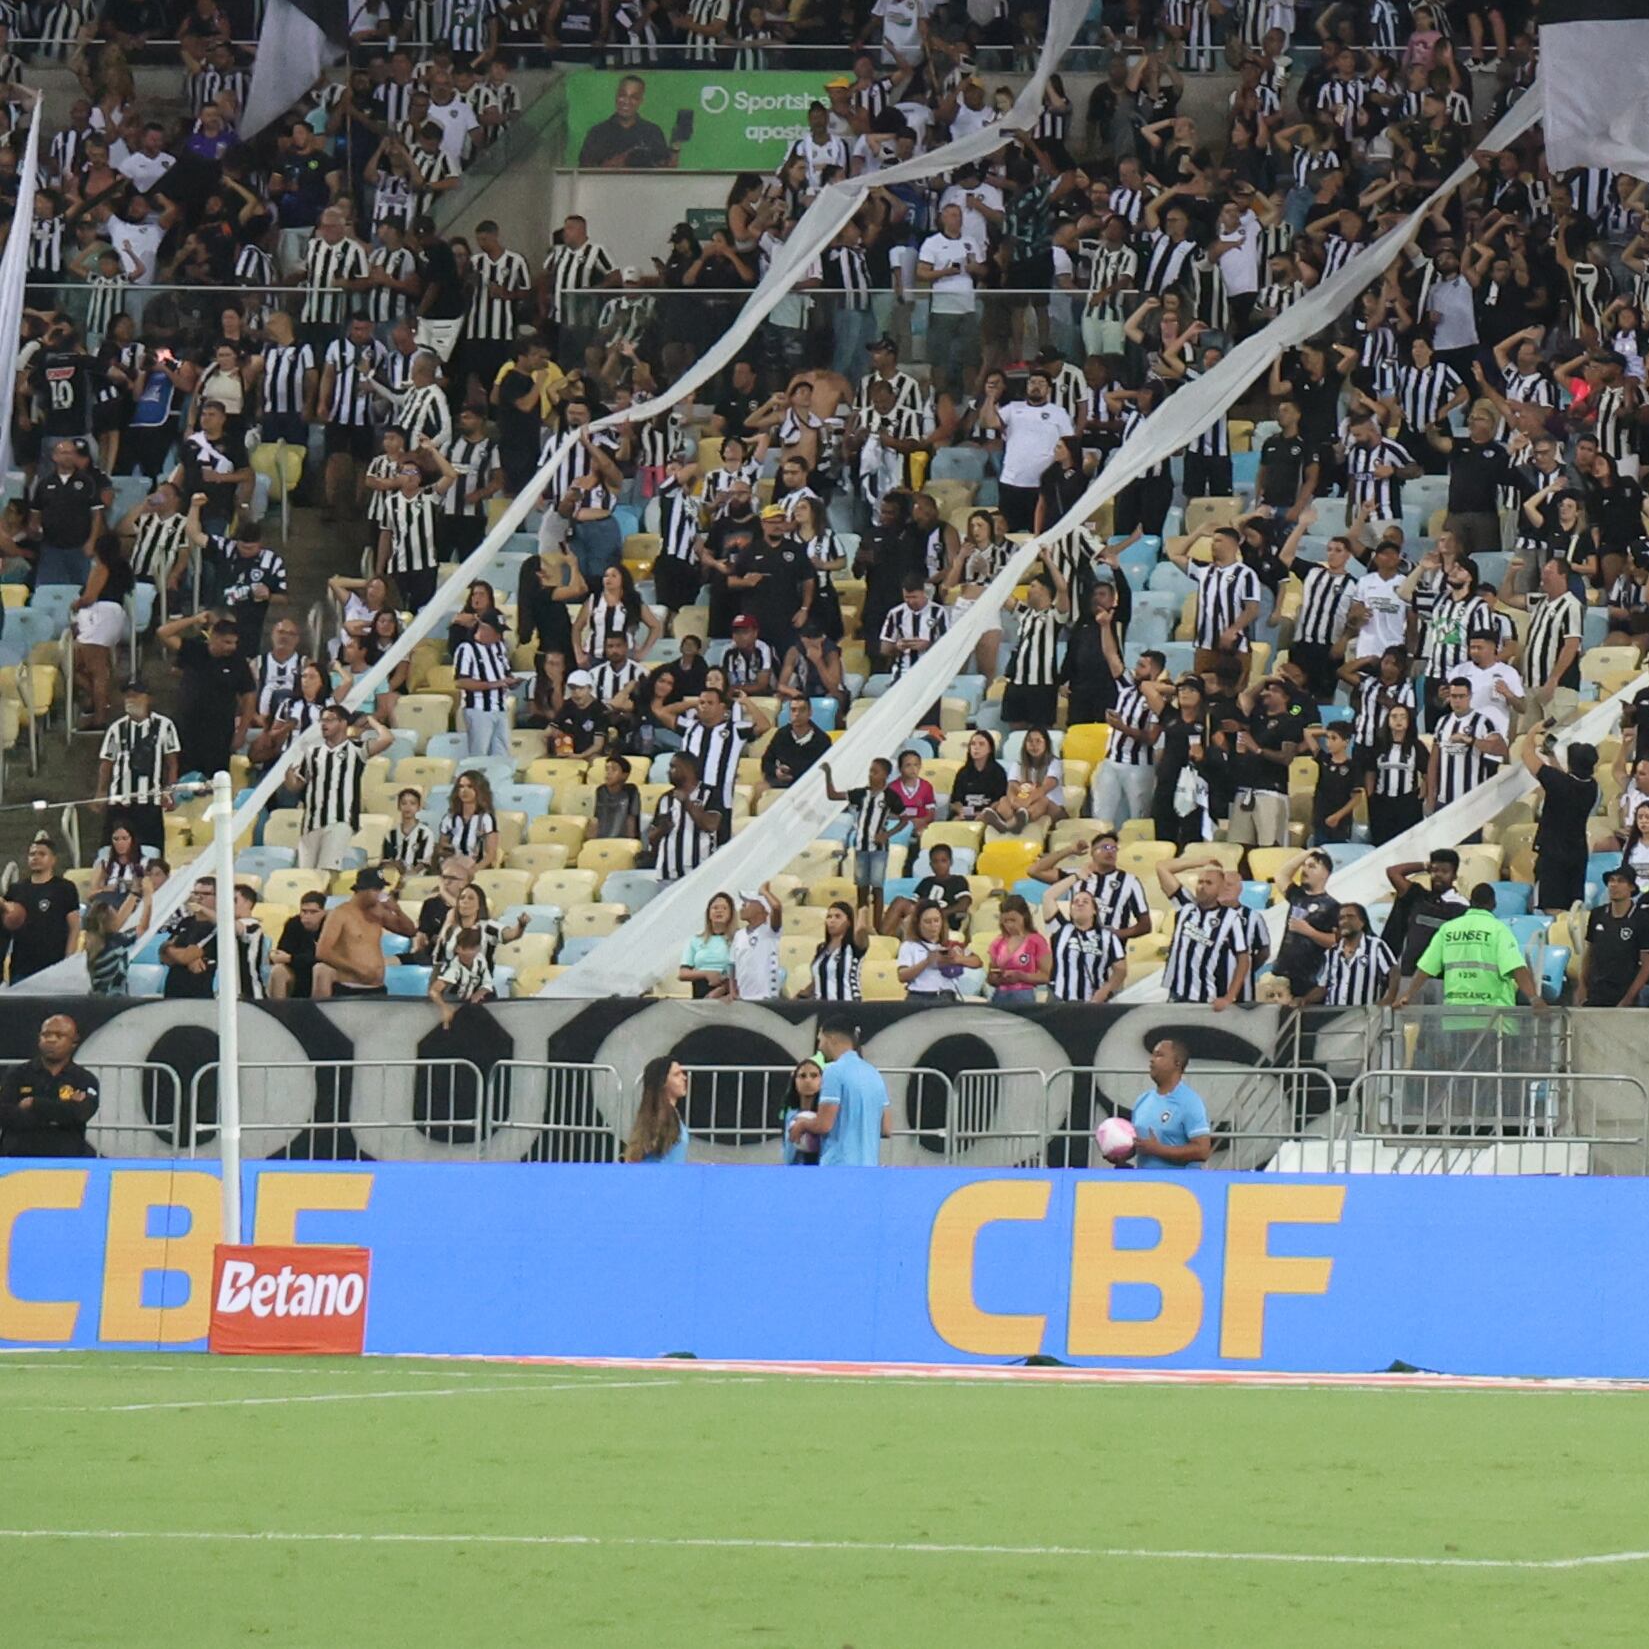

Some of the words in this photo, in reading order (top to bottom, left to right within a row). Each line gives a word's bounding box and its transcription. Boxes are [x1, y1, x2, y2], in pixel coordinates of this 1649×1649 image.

[1445, 930, 1491, 942] SUNSET
[216, 1260, 364, 1318] Betano
[929, 1180, 1346, 1358] CBF
